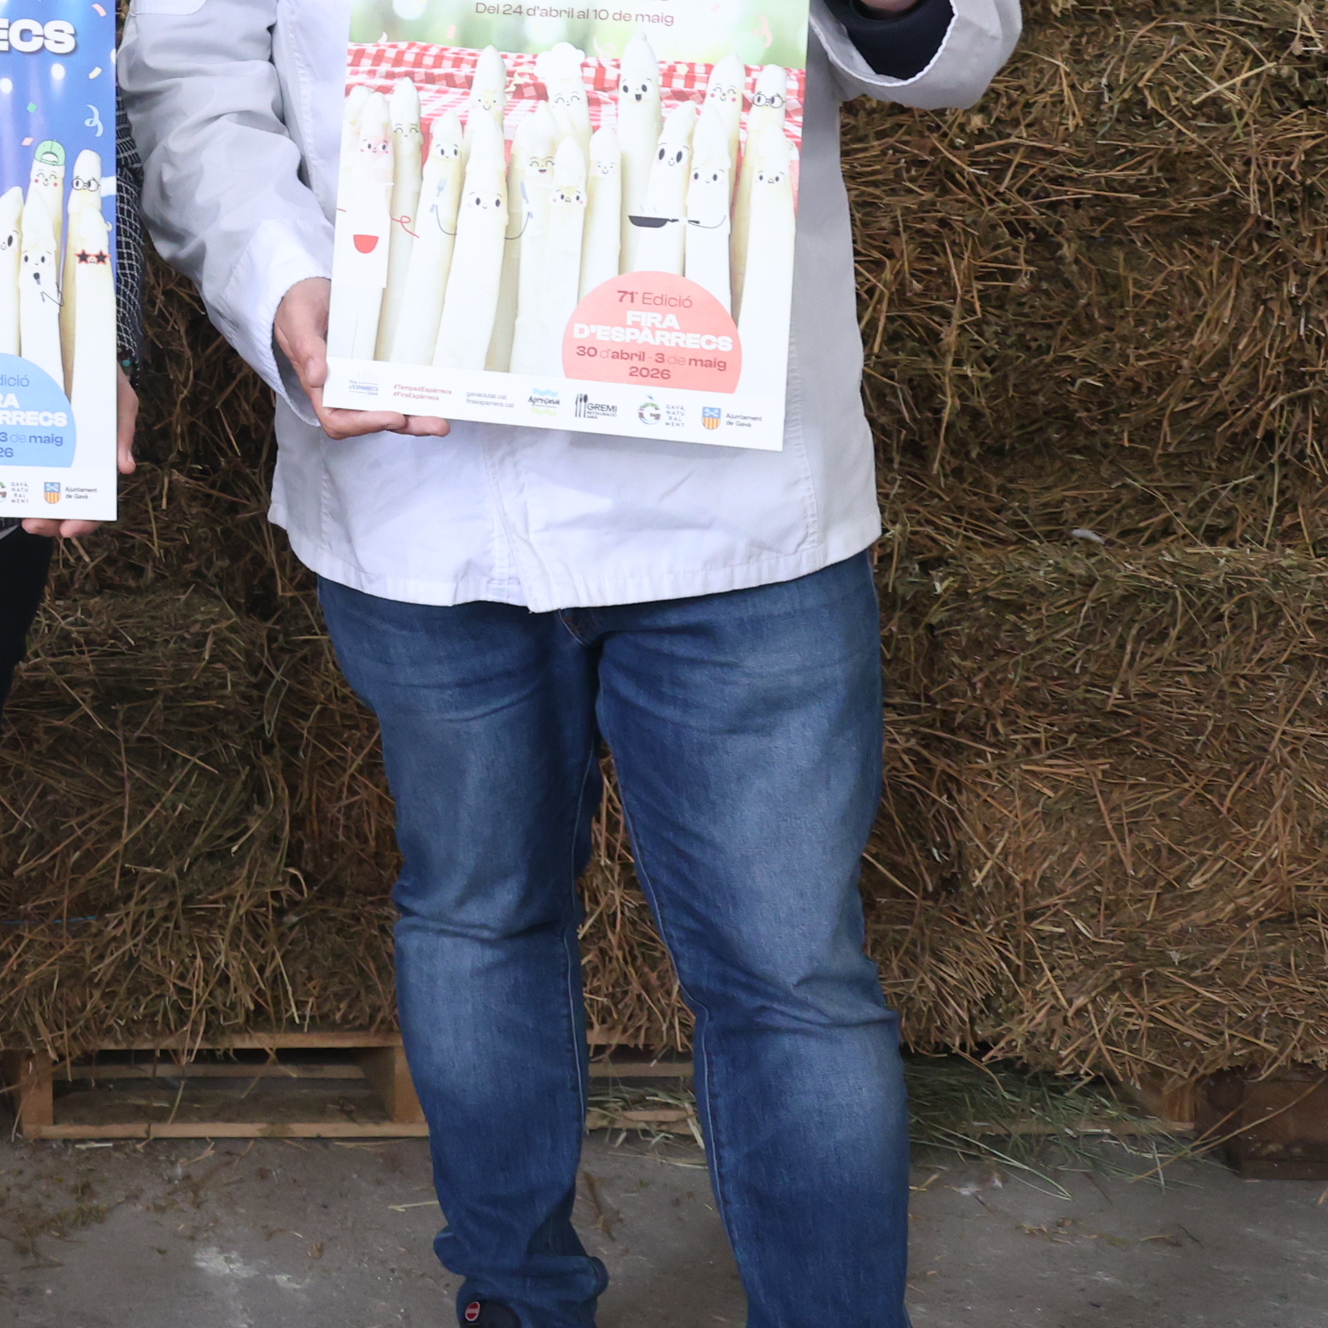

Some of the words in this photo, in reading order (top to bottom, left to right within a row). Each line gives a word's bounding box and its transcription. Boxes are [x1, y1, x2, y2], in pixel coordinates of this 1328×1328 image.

[475, 2, 500, 14] Del
[502, 4, 524, 16] 24
[576, 8, 589, 19] al
[593, 9, 609, 20] 10
[612, 10, 632, 22] de
[635, 12, 674, 27] maig
[642, 292, 693, 309] Edició
[626, 310, 681, 330] FIRA
[576, 345, 597, 358] 30
[654, 353, 666, 364] 3
[667, 354, 686, 366] de
[688, 357, 727, 371] maig
[628, 366, 671, 380] 2026
[586, 403, 618, 412] GREMI
[10, 432, 27, 443] de
[28, 433, 64, 447] maig
